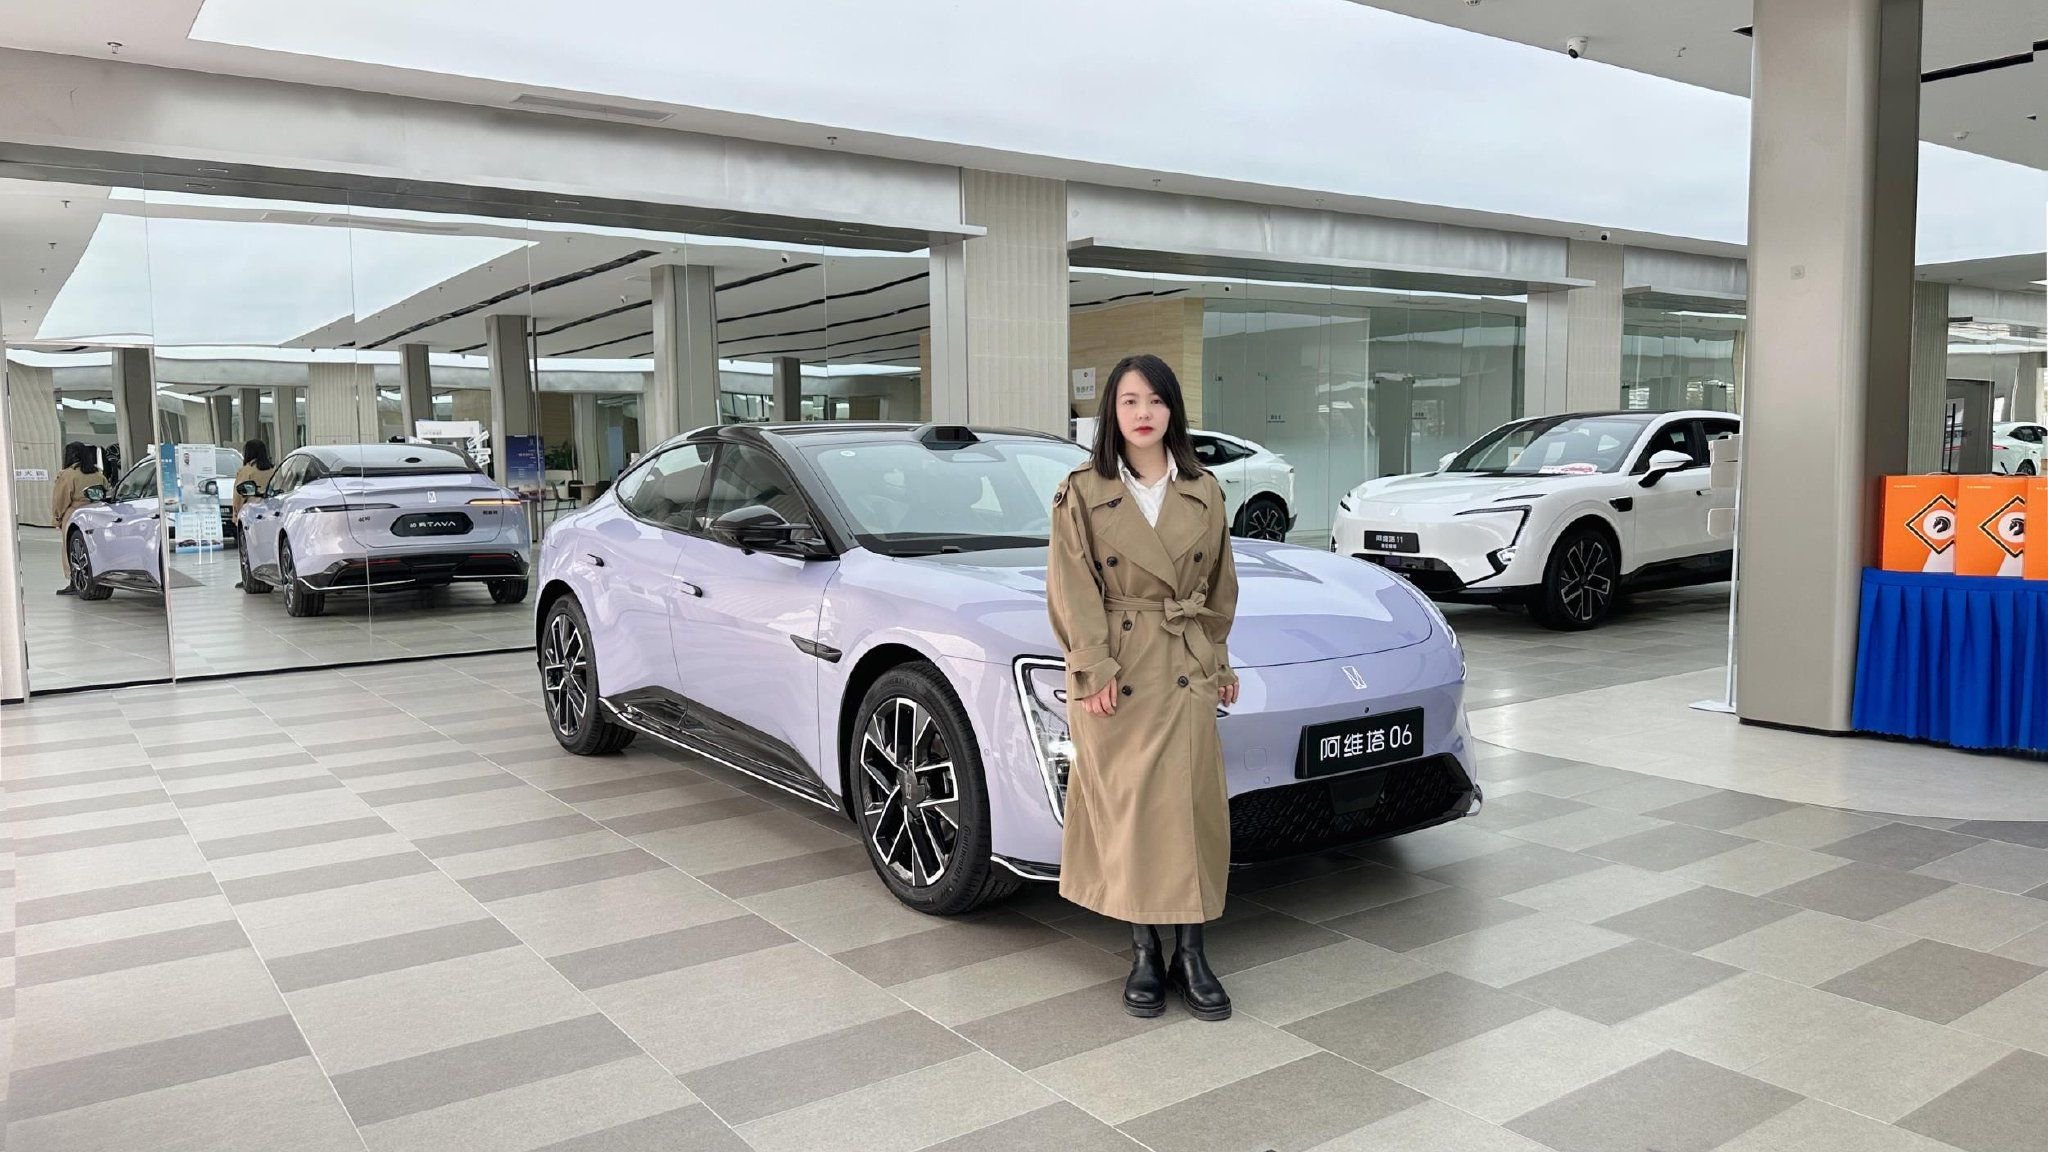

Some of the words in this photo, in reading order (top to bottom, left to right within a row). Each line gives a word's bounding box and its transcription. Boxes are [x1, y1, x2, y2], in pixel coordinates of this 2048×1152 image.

[1320, 728, 1385, 761] 阿维塔
[1389, 723, 1413, 749] 06
